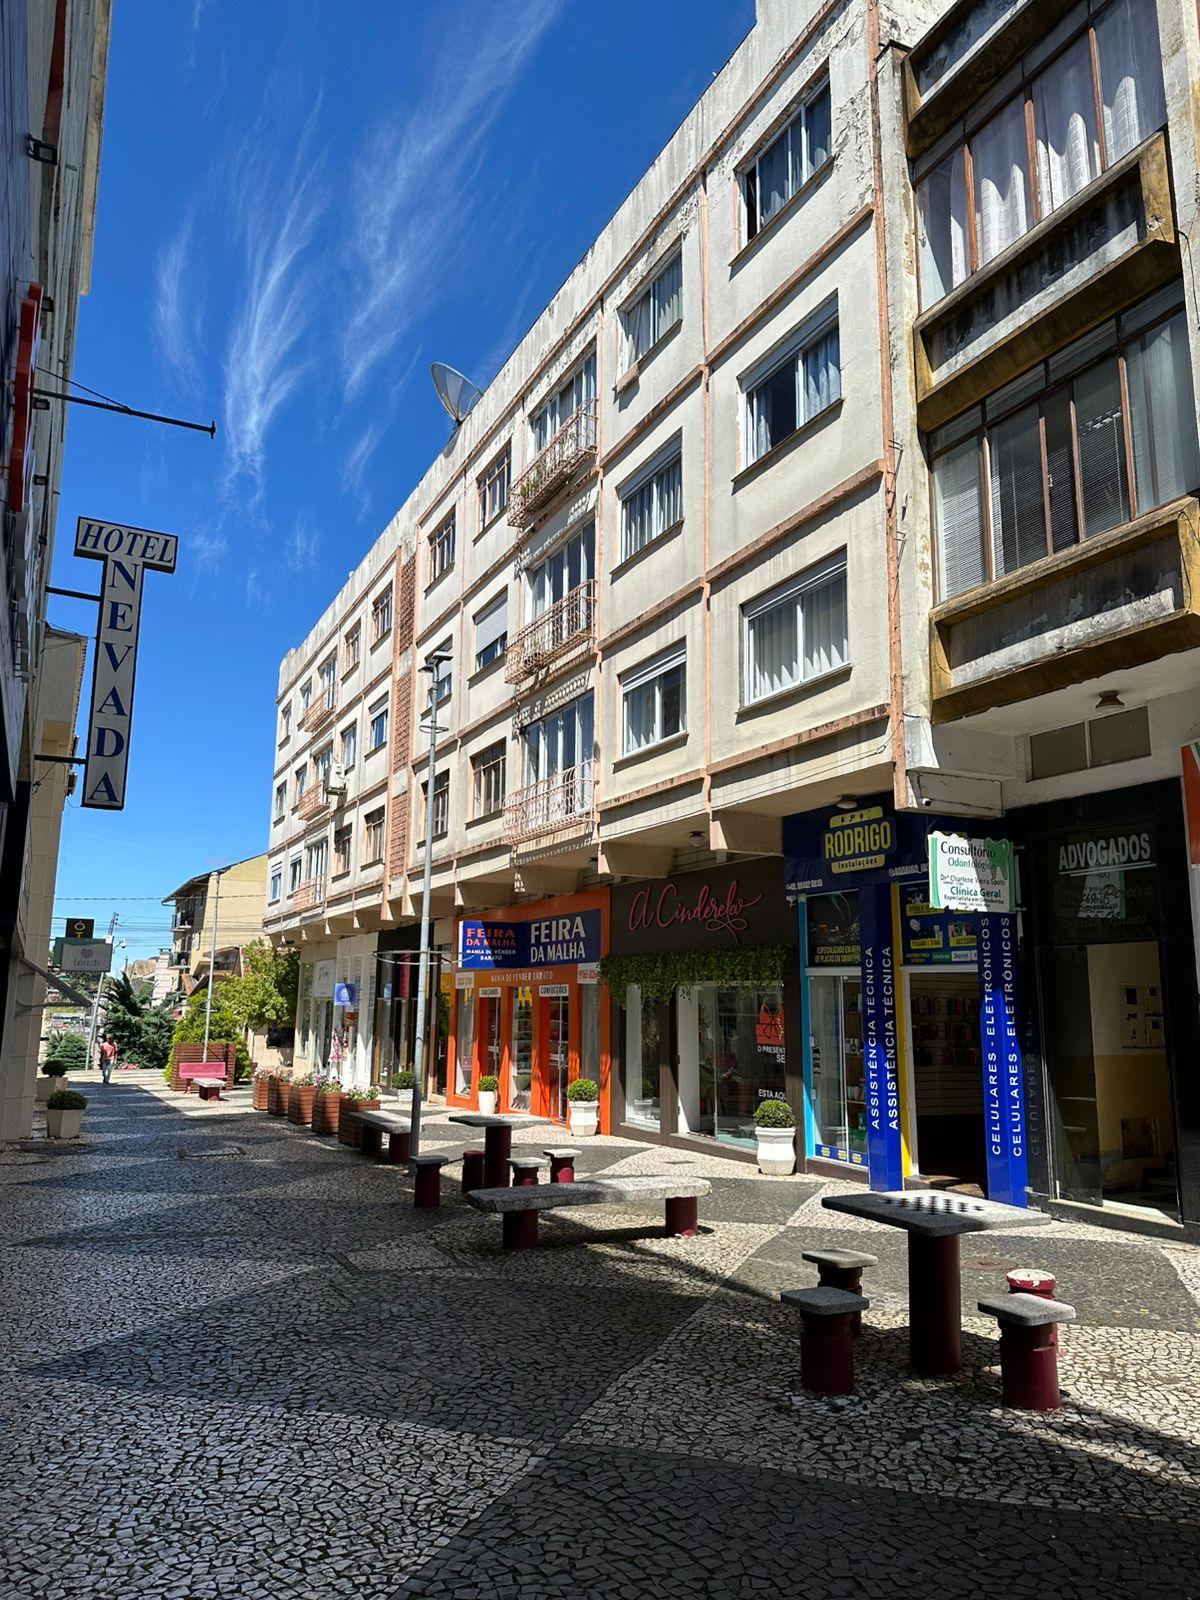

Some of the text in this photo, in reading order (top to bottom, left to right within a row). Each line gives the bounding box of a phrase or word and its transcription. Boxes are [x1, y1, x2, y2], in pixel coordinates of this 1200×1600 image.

[79, 522, 174, 563] HOTEL
[87, 558, 140, 803] NEVADA
[824, 821, 891, 859] RODRIGO
[940, 841, 996, 858] Consultório
[1058, 833, 1151, 870] ADVOGADOS
[950, 886, 1001, 898] Clínica Geral
[466, 928, 516, 938] FEIRA
[466, 938, 516, 947] DA MALHA
[530, 916, 586, 944] FEIRA
[530, 941, 586, 963] DA MALHA
[981, 918, 995, 1036] ELETRÔNICOS
[1001, 918, 1016, 1036] ELETRÔNICOS
[865, 946, 880, 1130] ASSISTÊNCIA TÉCNICA
[882, 946, 898, 1130] ASSISTÊNCIA TÉCNICA
[758, 1089, 773, 1099] ESTA
[988, 1052, 1001, 1155] CELULARES
[1008, 1054, 1022, 1156] CELULARES
